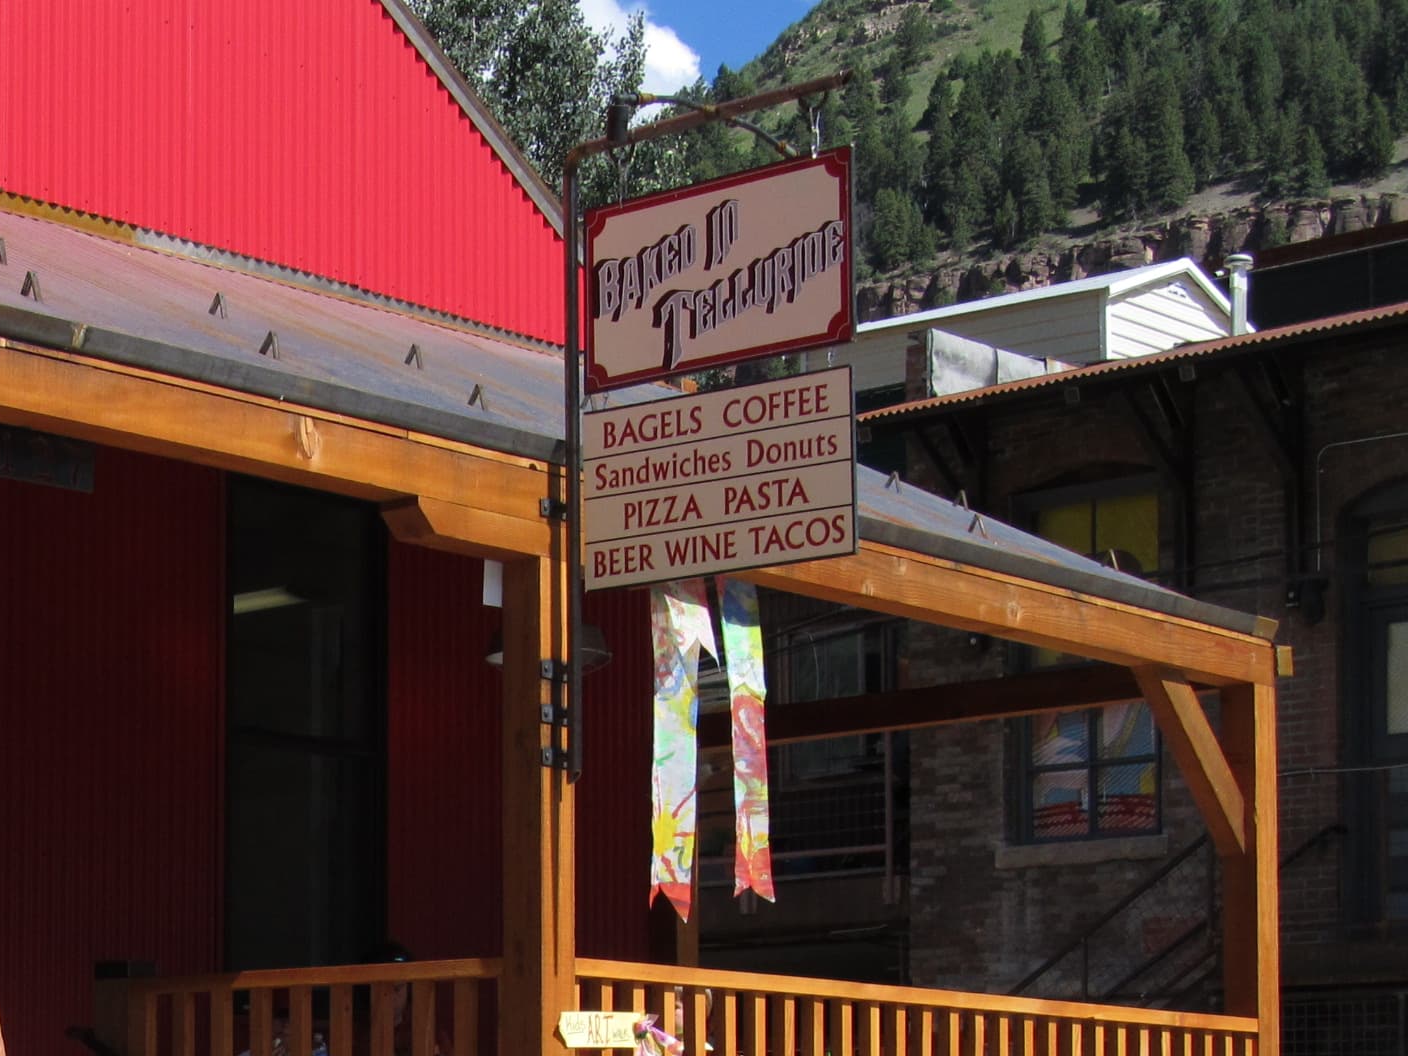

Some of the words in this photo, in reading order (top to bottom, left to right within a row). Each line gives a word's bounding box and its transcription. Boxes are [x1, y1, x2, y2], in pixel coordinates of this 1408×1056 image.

[592, 224, 697, 323] BAKED
[652, 220, 845, 371] TELLURIDE
[602, 405, 702, 450] BAGELS
[722, 383, 830, 429] COFFEE
[594, 448, 732, 491] Sandwiches
[745, 432, 838, 468] Donuts
[623, 495, 702, 530] PIZZA
[723, 477, 810, 517] PASTA
[593, 543, 655, 579] BEER
[665, 529, 738, 568] WINE
[748, 513, 846, 555] TACOS
[587, 1013, 614, 1045] ART
